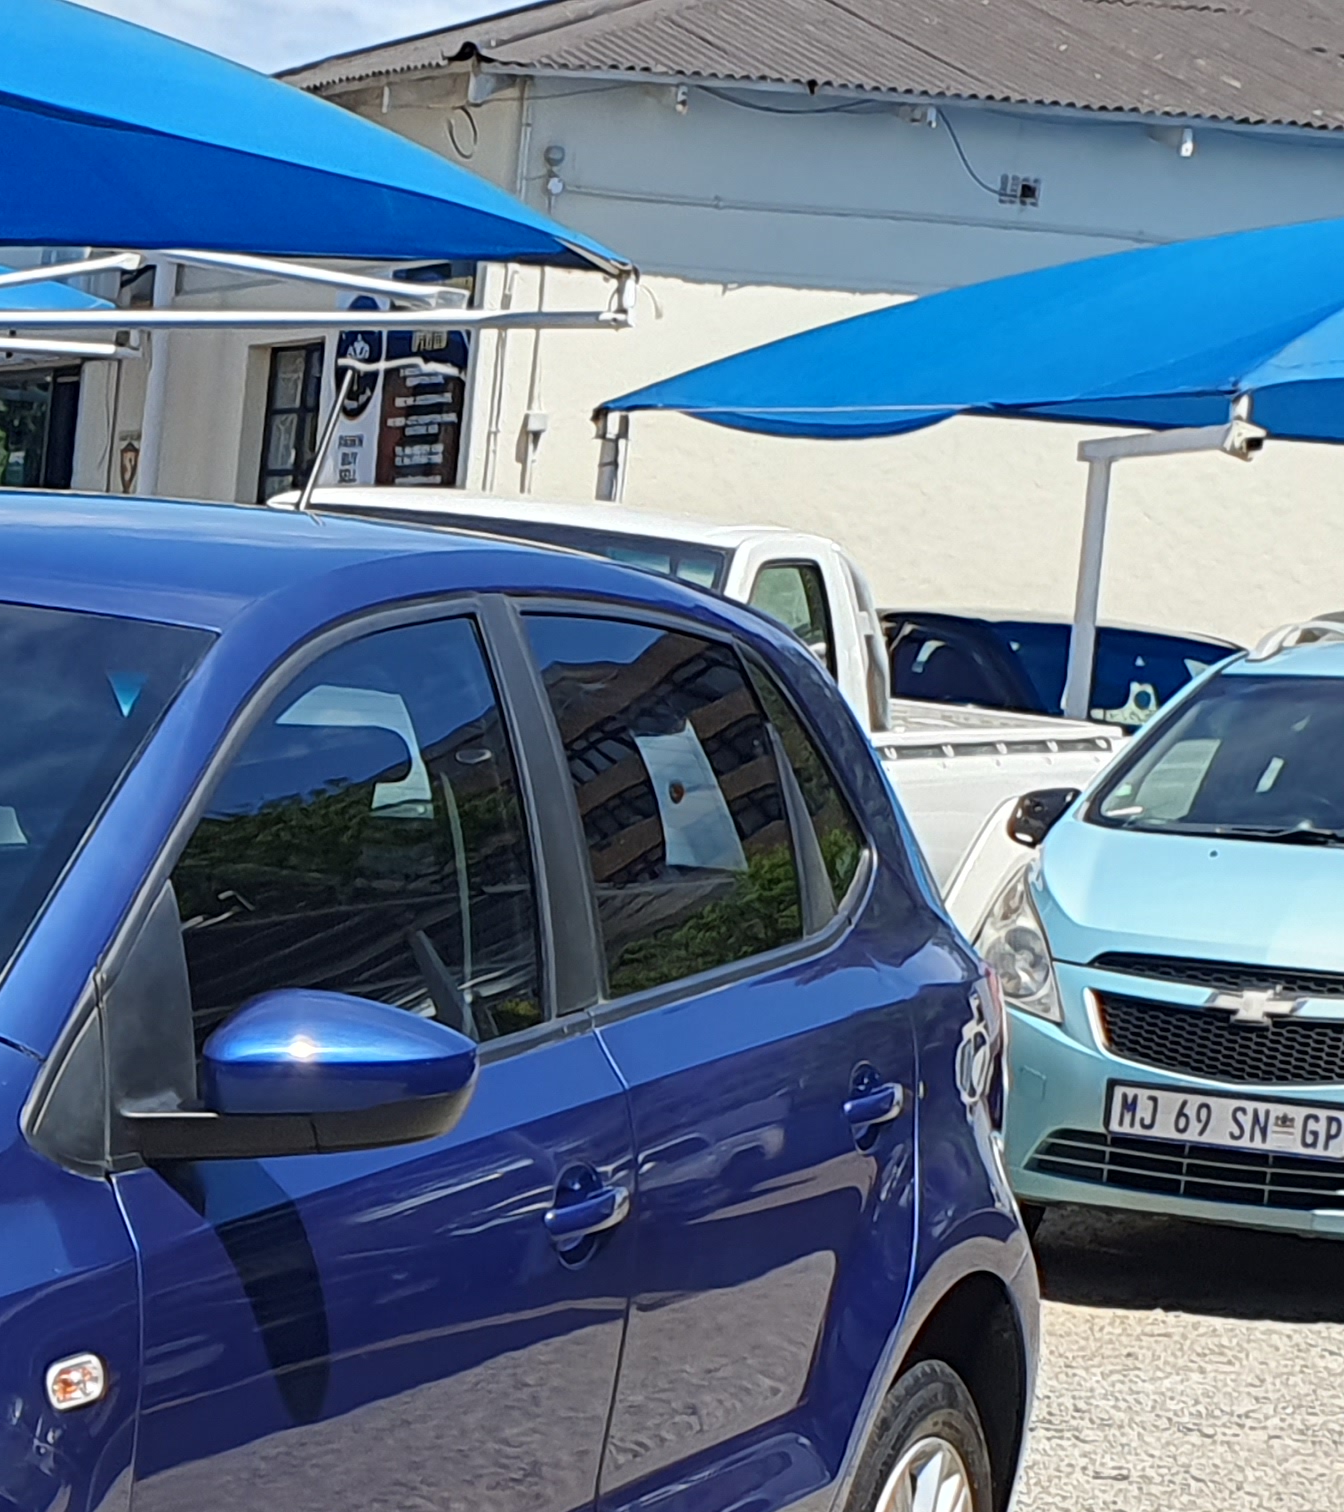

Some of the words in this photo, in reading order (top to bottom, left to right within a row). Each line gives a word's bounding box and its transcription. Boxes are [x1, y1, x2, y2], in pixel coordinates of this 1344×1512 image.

[1118, 1092, 1159, 1131] MJ
[1174, 1099, 1213, 1138] 69
[1229, 1106, 1271, 1145] SN
[1300, 1113, 1343, 1152] GP
